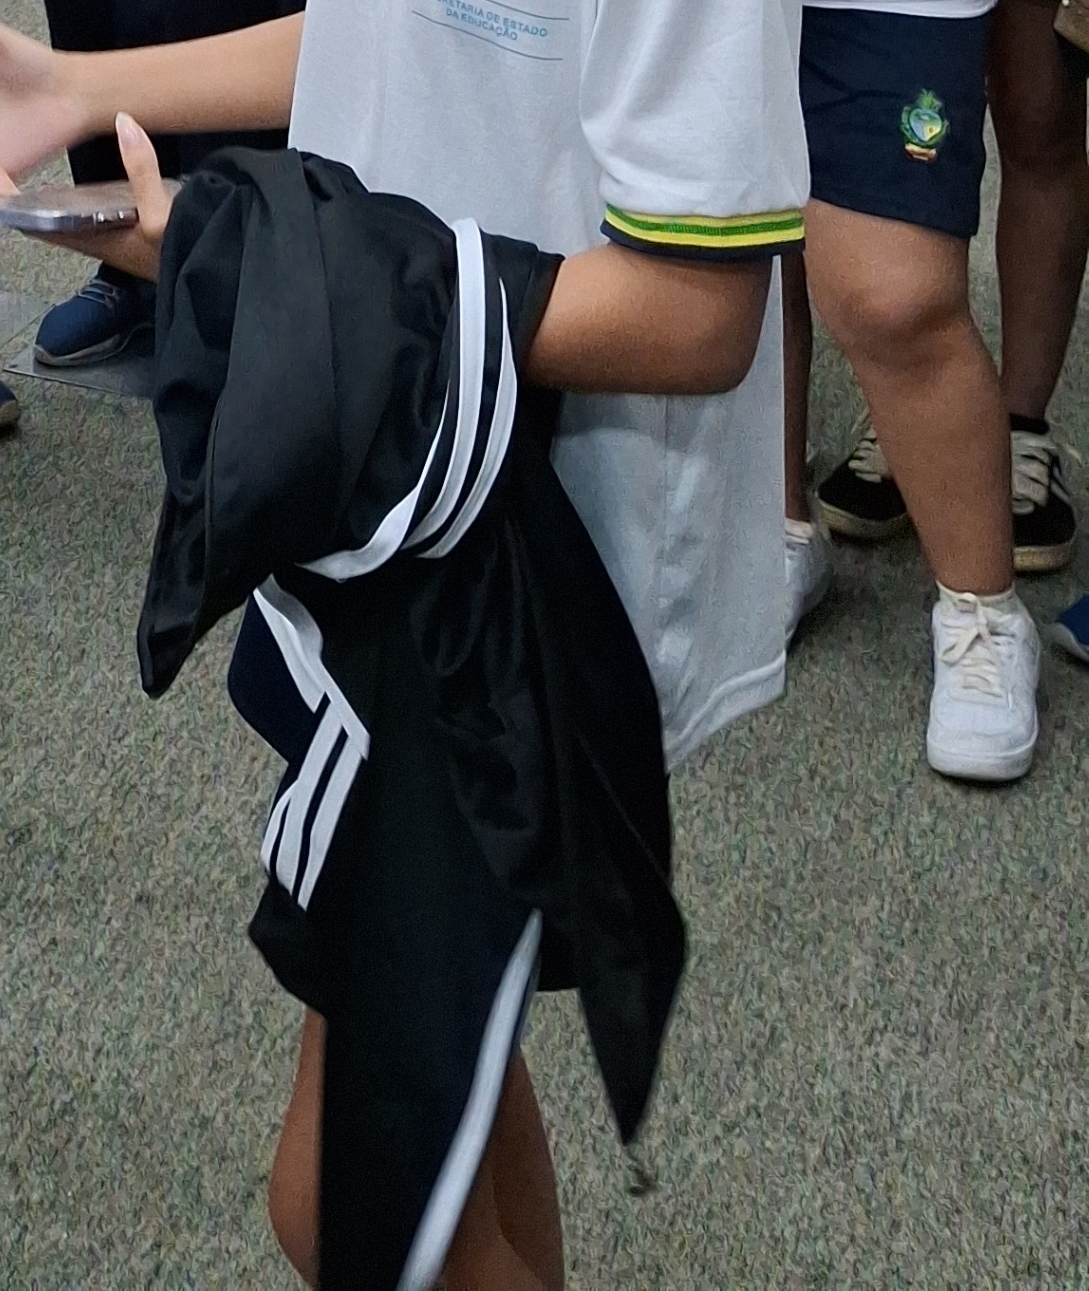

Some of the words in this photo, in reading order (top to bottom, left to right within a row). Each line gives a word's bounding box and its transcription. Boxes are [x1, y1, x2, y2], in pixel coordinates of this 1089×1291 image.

[445, 7, 460, 20] DA
[486, 11, 501, 24] DE
[502, 17, 548, 38] ESTADO
